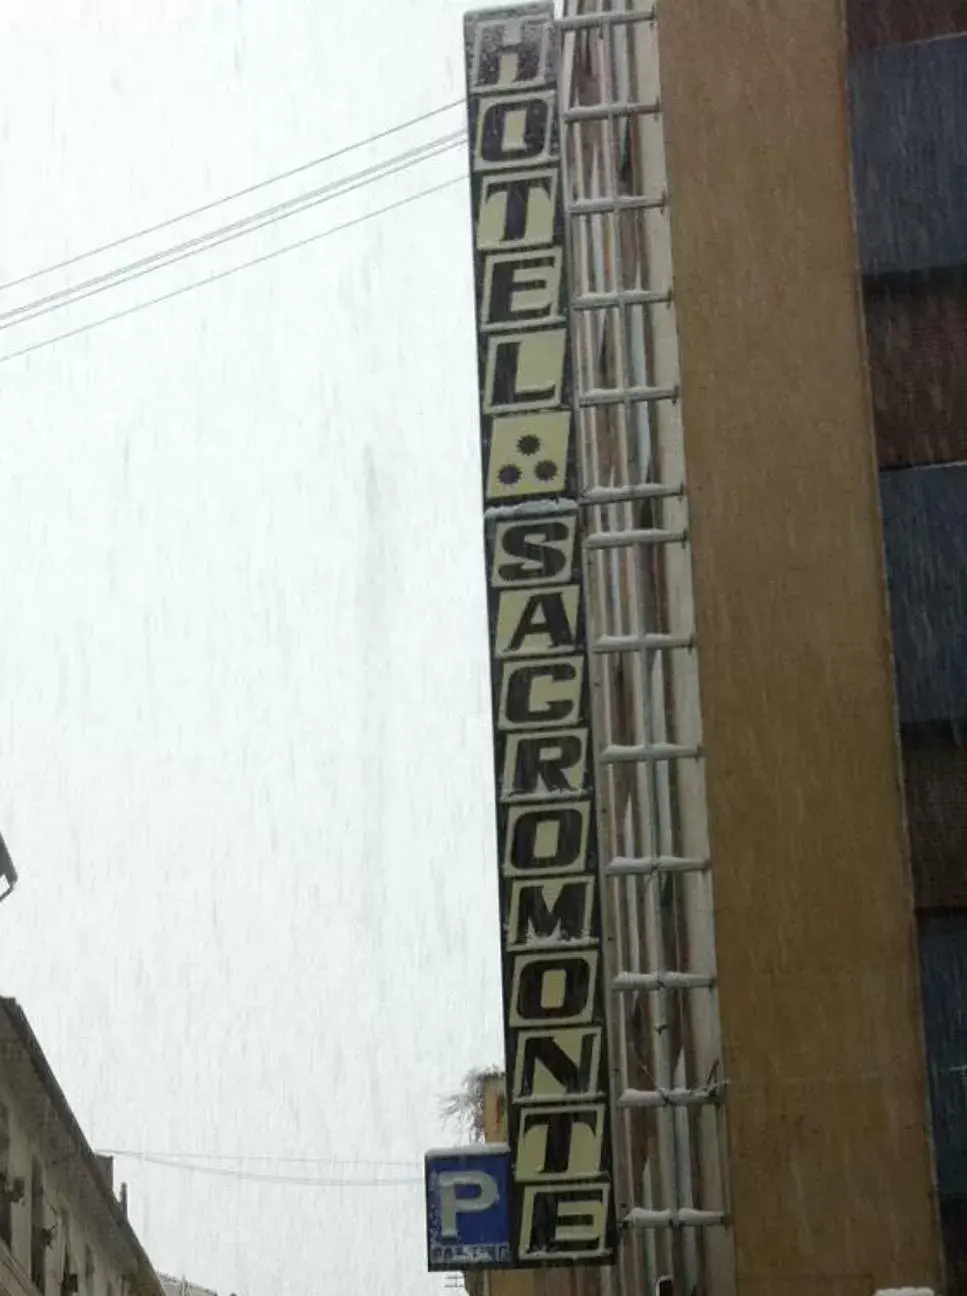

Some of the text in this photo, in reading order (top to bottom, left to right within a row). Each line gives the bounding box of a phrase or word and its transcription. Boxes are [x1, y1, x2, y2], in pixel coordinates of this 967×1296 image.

[472, 19, 605, 1254] HOTEL SACROMONTE
[438, 1170, 500, 1237] P
